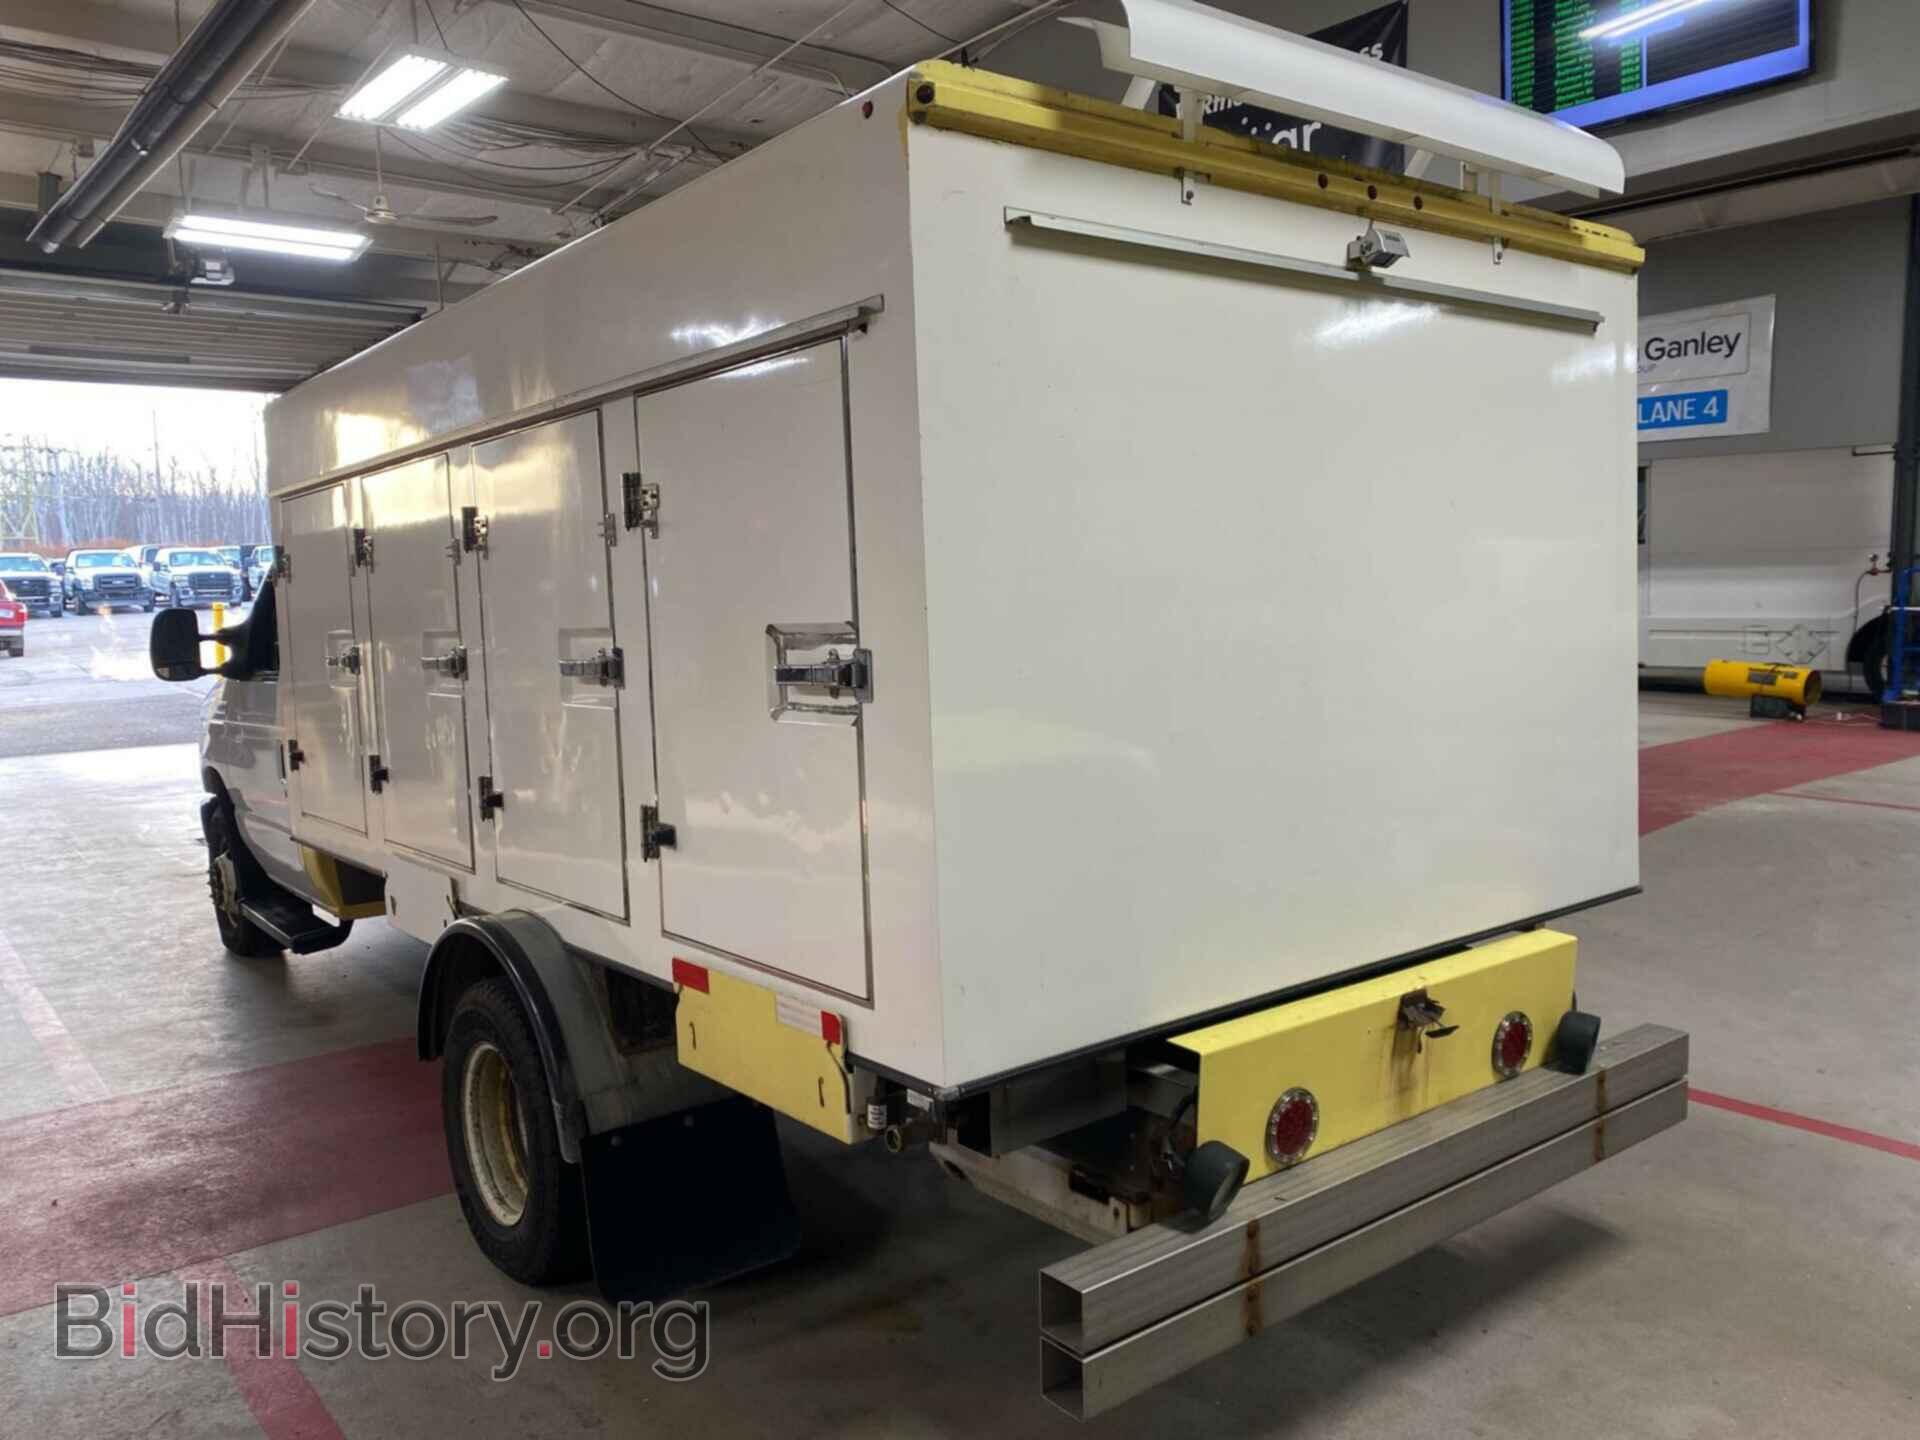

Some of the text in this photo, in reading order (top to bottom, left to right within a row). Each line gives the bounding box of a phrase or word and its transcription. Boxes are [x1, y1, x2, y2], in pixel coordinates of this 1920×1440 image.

[1644, 331, 1742, 361] Ganley
[1638, 396, 1719, 424] LANE 4
